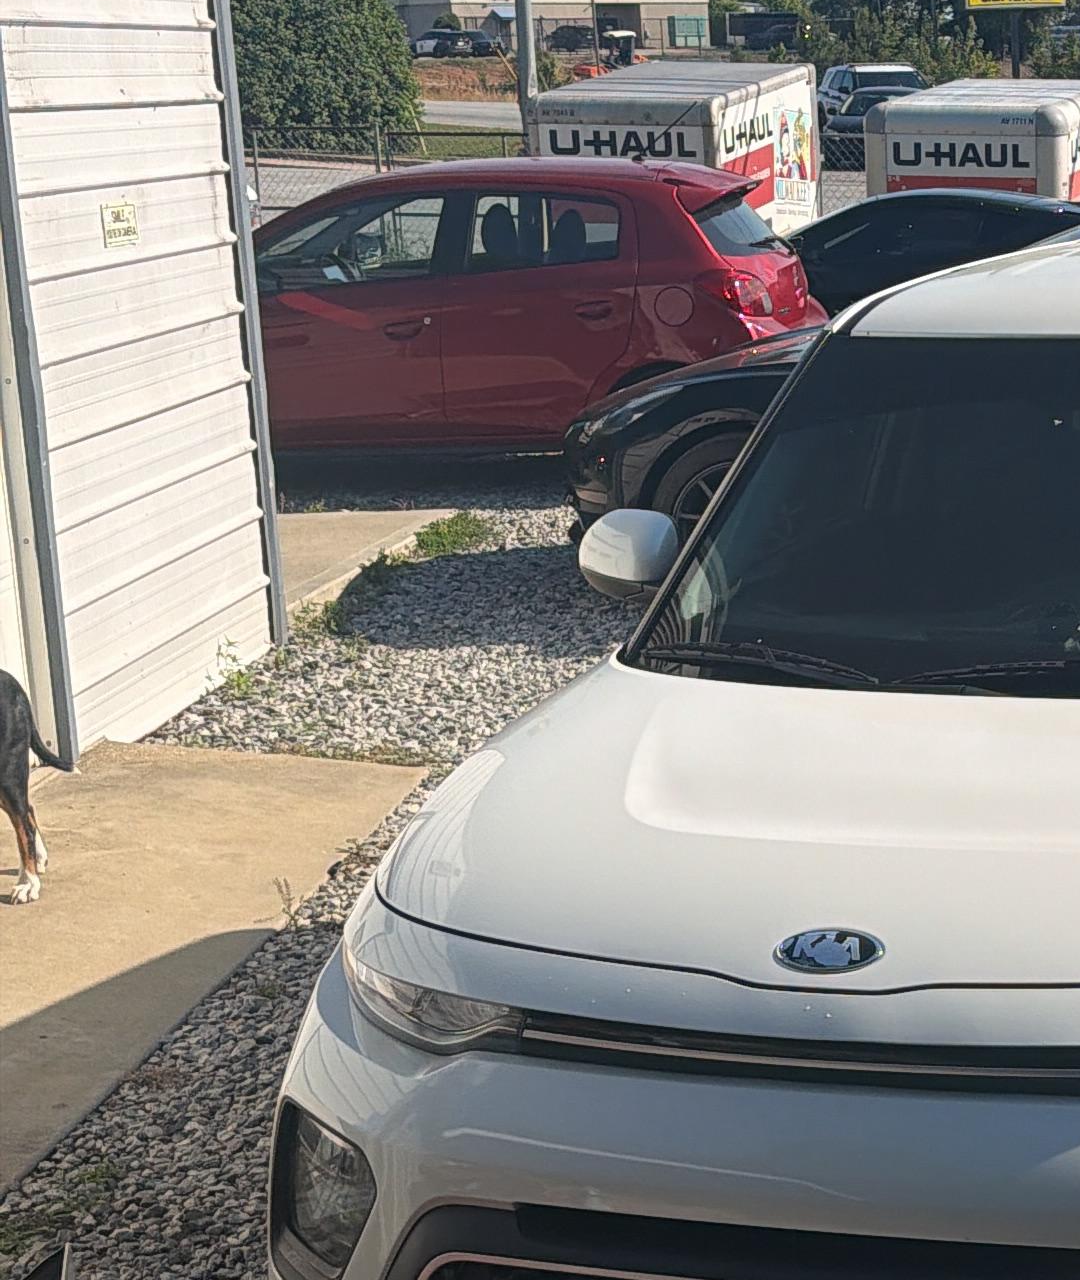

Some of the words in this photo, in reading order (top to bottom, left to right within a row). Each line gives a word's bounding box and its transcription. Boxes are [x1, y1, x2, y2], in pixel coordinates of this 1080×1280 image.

[549, 129, 697, 158] U-HAUL
[723, 113, 773, 154] U-HAUL
[892, 141, 1030, 168] U-HAUL
